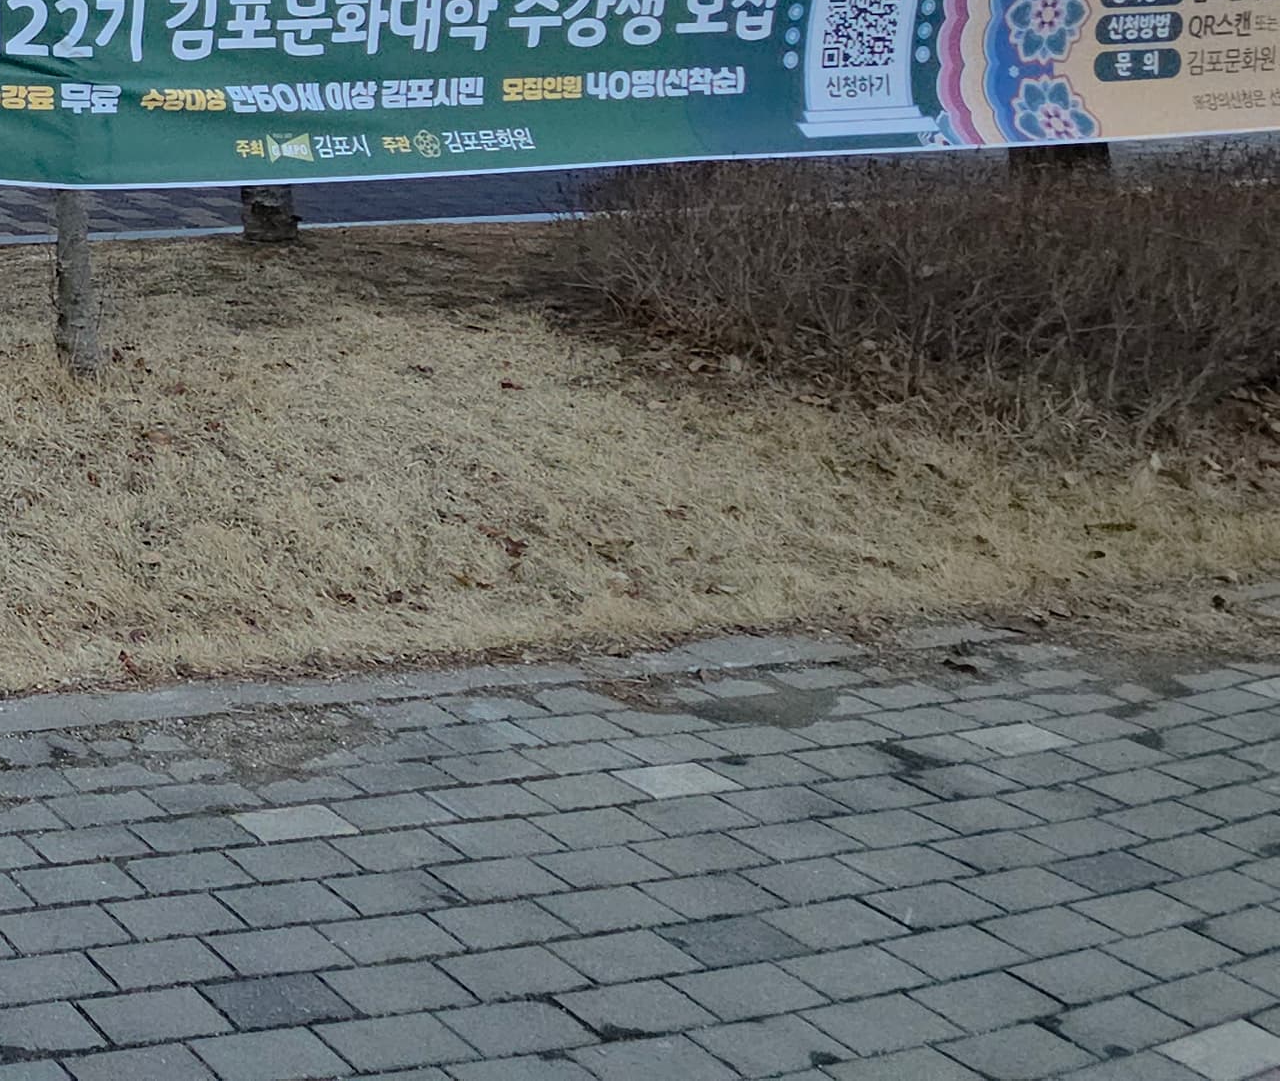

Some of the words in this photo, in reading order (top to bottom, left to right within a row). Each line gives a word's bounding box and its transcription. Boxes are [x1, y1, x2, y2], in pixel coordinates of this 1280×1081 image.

[1108, 13, 1172, 40] 신청방법
[1188, 11, 1253, 39] QR스캔
[1187, 45, 1276, 76] 김포문화원
[60, 83, 122, 114] 무료
[140, 88, 226, 112] 수강대상
[225, 82, 325, 113] 만60세
[324, 81, 378, 111] 이상
[381, 76, 484, 110] 김포시민
[502, 76, 583, 102] 모집인원
[586, 66, 746, 100] 40명(선착순)
[826, 73, 891, 98] 신청하기
[236, 139, 265, 158] 주최
[314, 134, 372, 158] 김포시
[382, 135, 412, 154] 주관
[441, 128, 536, 154] 김포문화원
